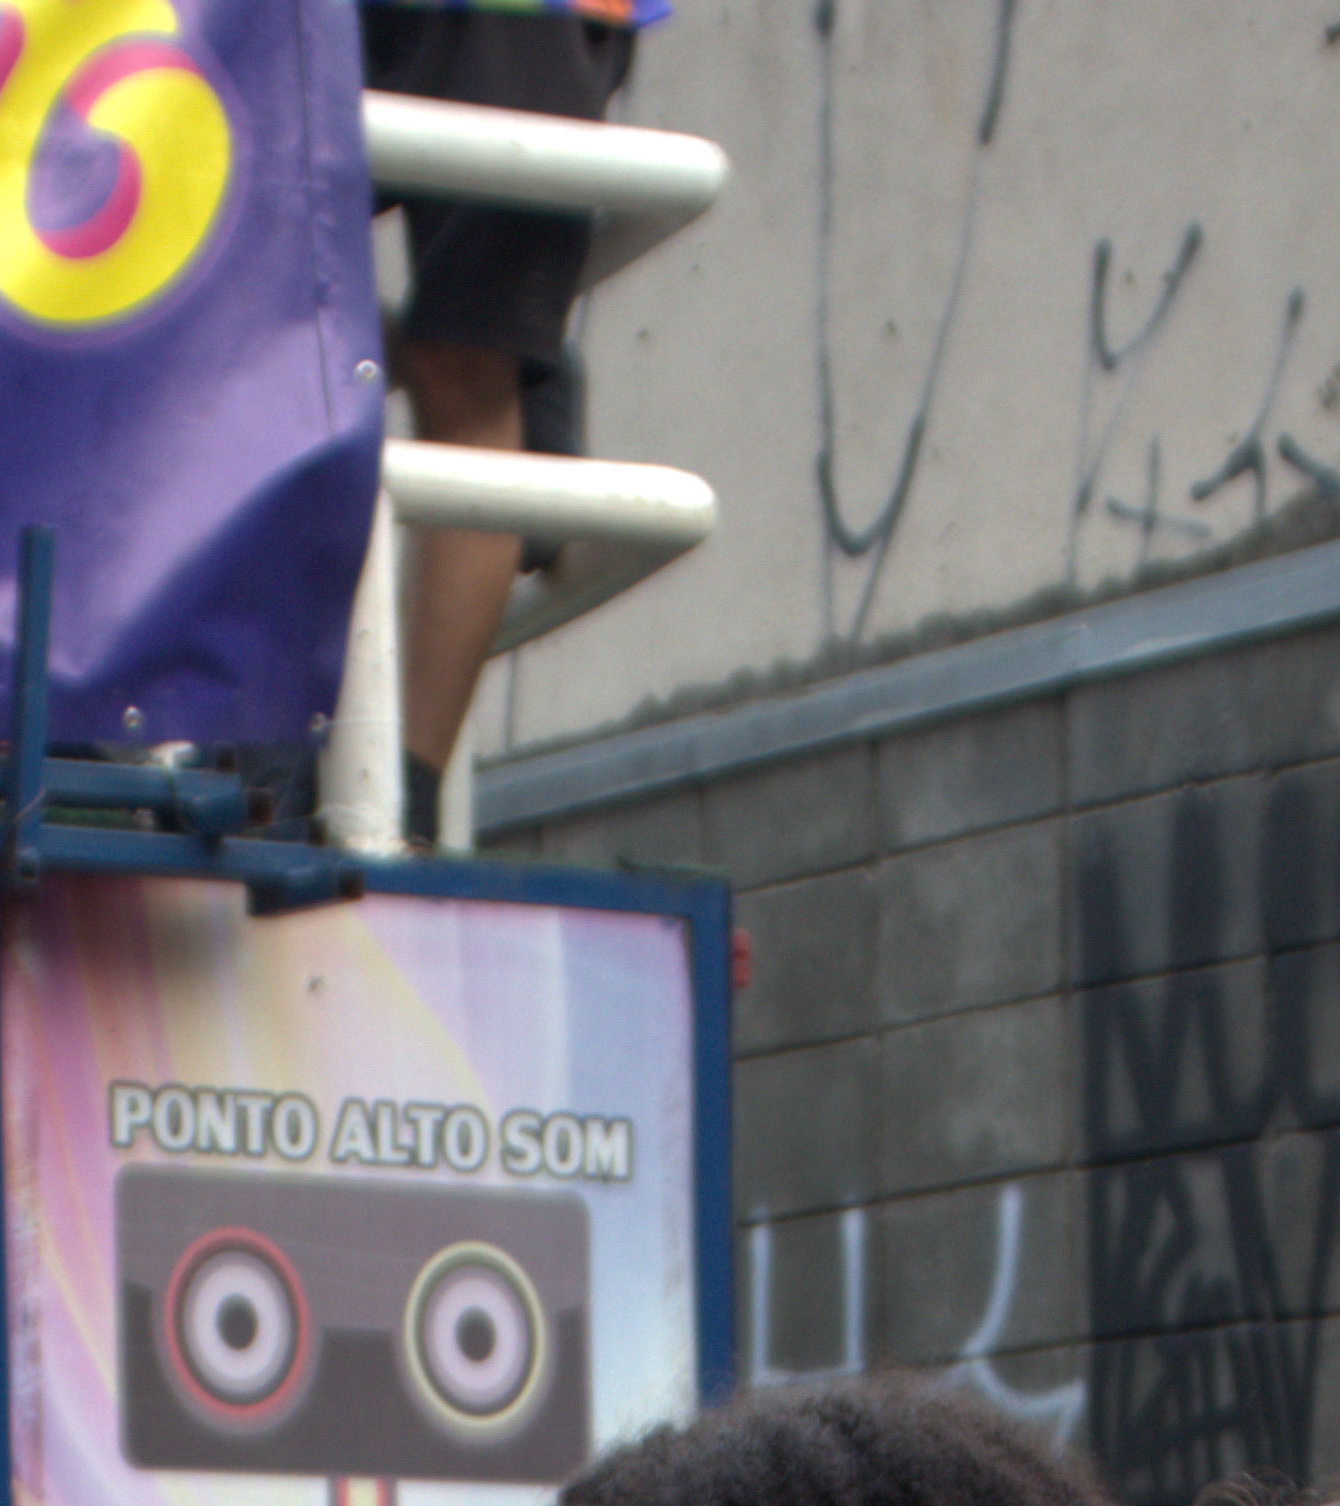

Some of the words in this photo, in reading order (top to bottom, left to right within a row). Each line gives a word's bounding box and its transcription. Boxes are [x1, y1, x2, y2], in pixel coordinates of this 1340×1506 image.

[109, 1081, 318, 1160] PONTO
[330, 1099, 489, 1169] ALTO
[499, 1111, 633, 1182] SOM
